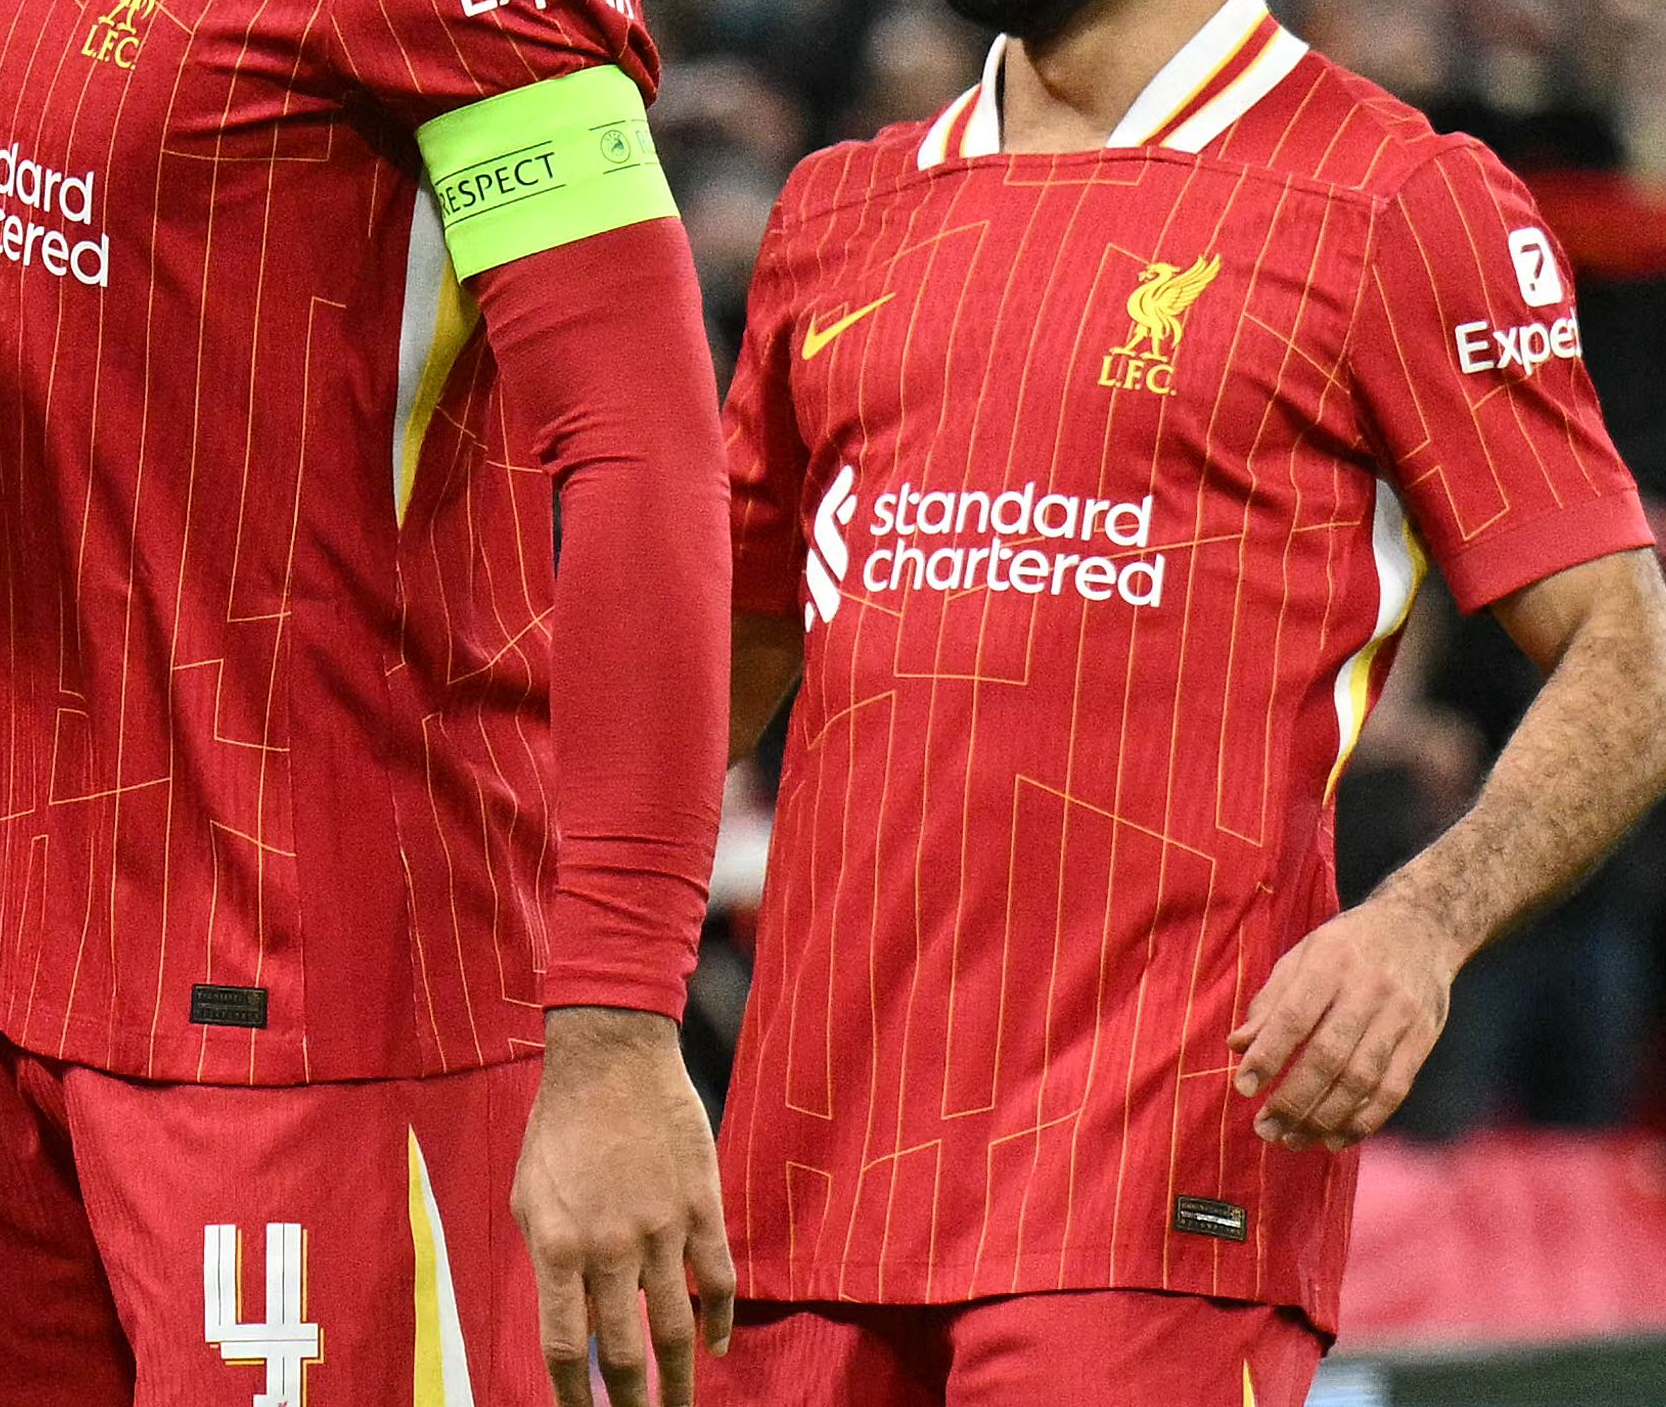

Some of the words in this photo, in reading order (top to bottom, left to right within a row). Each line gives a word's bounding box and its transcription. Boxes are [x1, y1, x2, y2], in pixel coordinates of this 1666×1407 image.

[438, 151, 555, 219] RESPECT
[1097, 354, 1178, 397] L.F.C.
[869, 480, 1154, 548] standard
[862, 537, 1166, 608] chartered
[203, 1223, 325, 1407] 4
